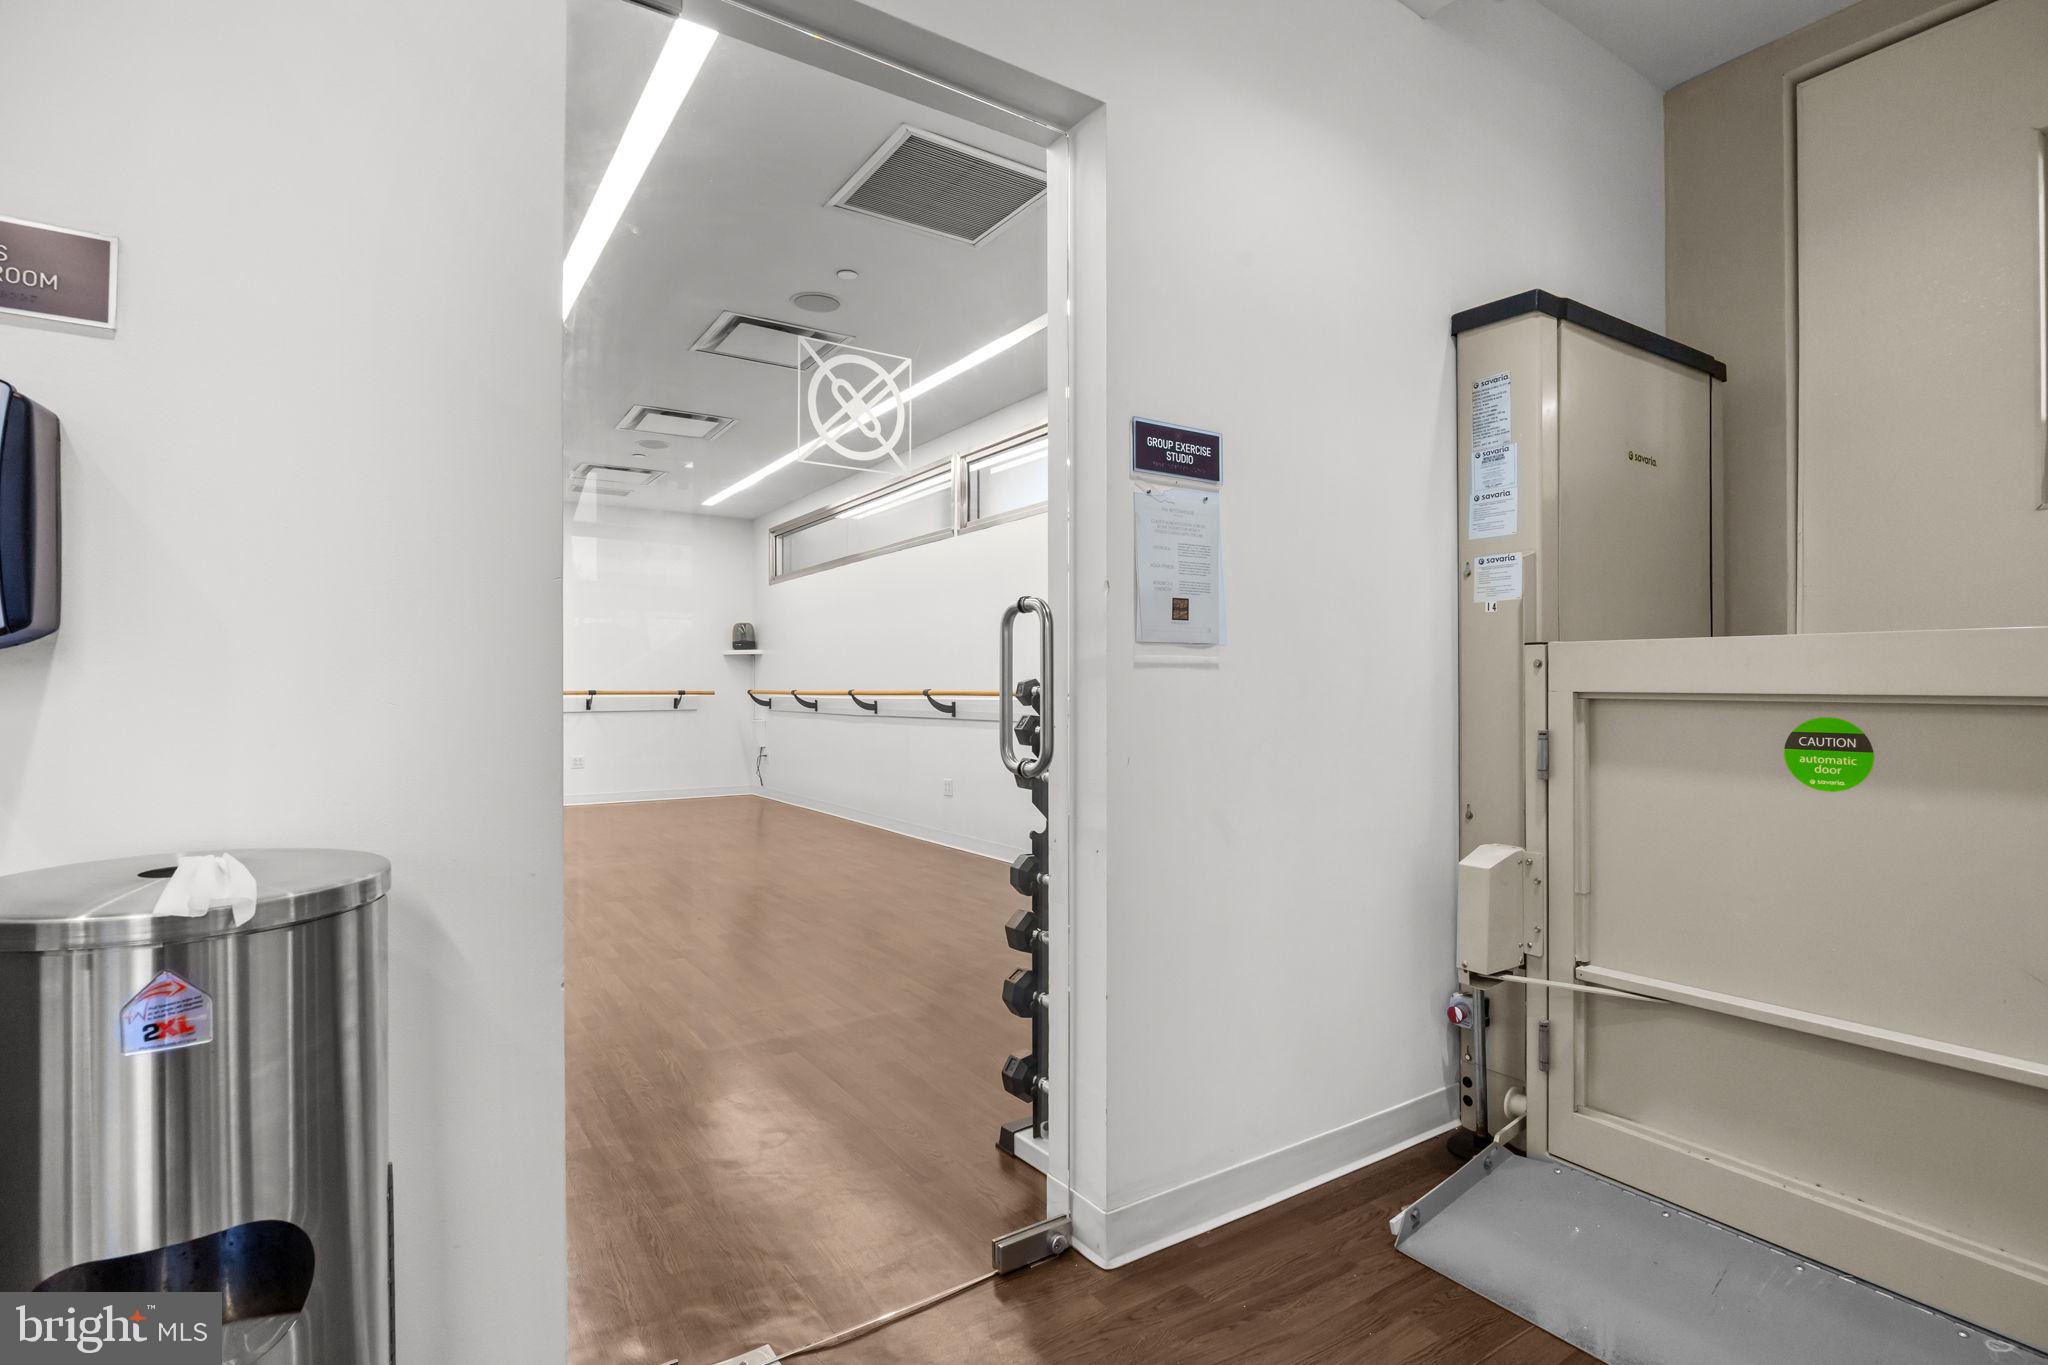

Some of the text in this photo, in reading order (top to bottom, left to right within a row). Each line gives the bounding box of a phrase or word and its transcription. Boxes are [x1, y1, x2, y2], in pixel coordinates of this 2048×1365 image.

[0, 265, 58, 290] OOM
[1481, 374, 1509, 387] savaria
[1146, 436, 1212, 457] GROUP EXERCISE
[1482, 445, 1510, 458] savaria
[1166, 451, 1194, 465] STUDIO
[1634, 453, 1657, 467] savaria
[1481, 489, 1511, 501] savaria
[1486, 554, 1516, 564] savaria
[1798, 736, 1857, 748] CAUTION
[1799, 755, 1857, 766] automatic
[1814, 765, 1842, 775] door
[142, 1015, 195, 1042] 2XL
